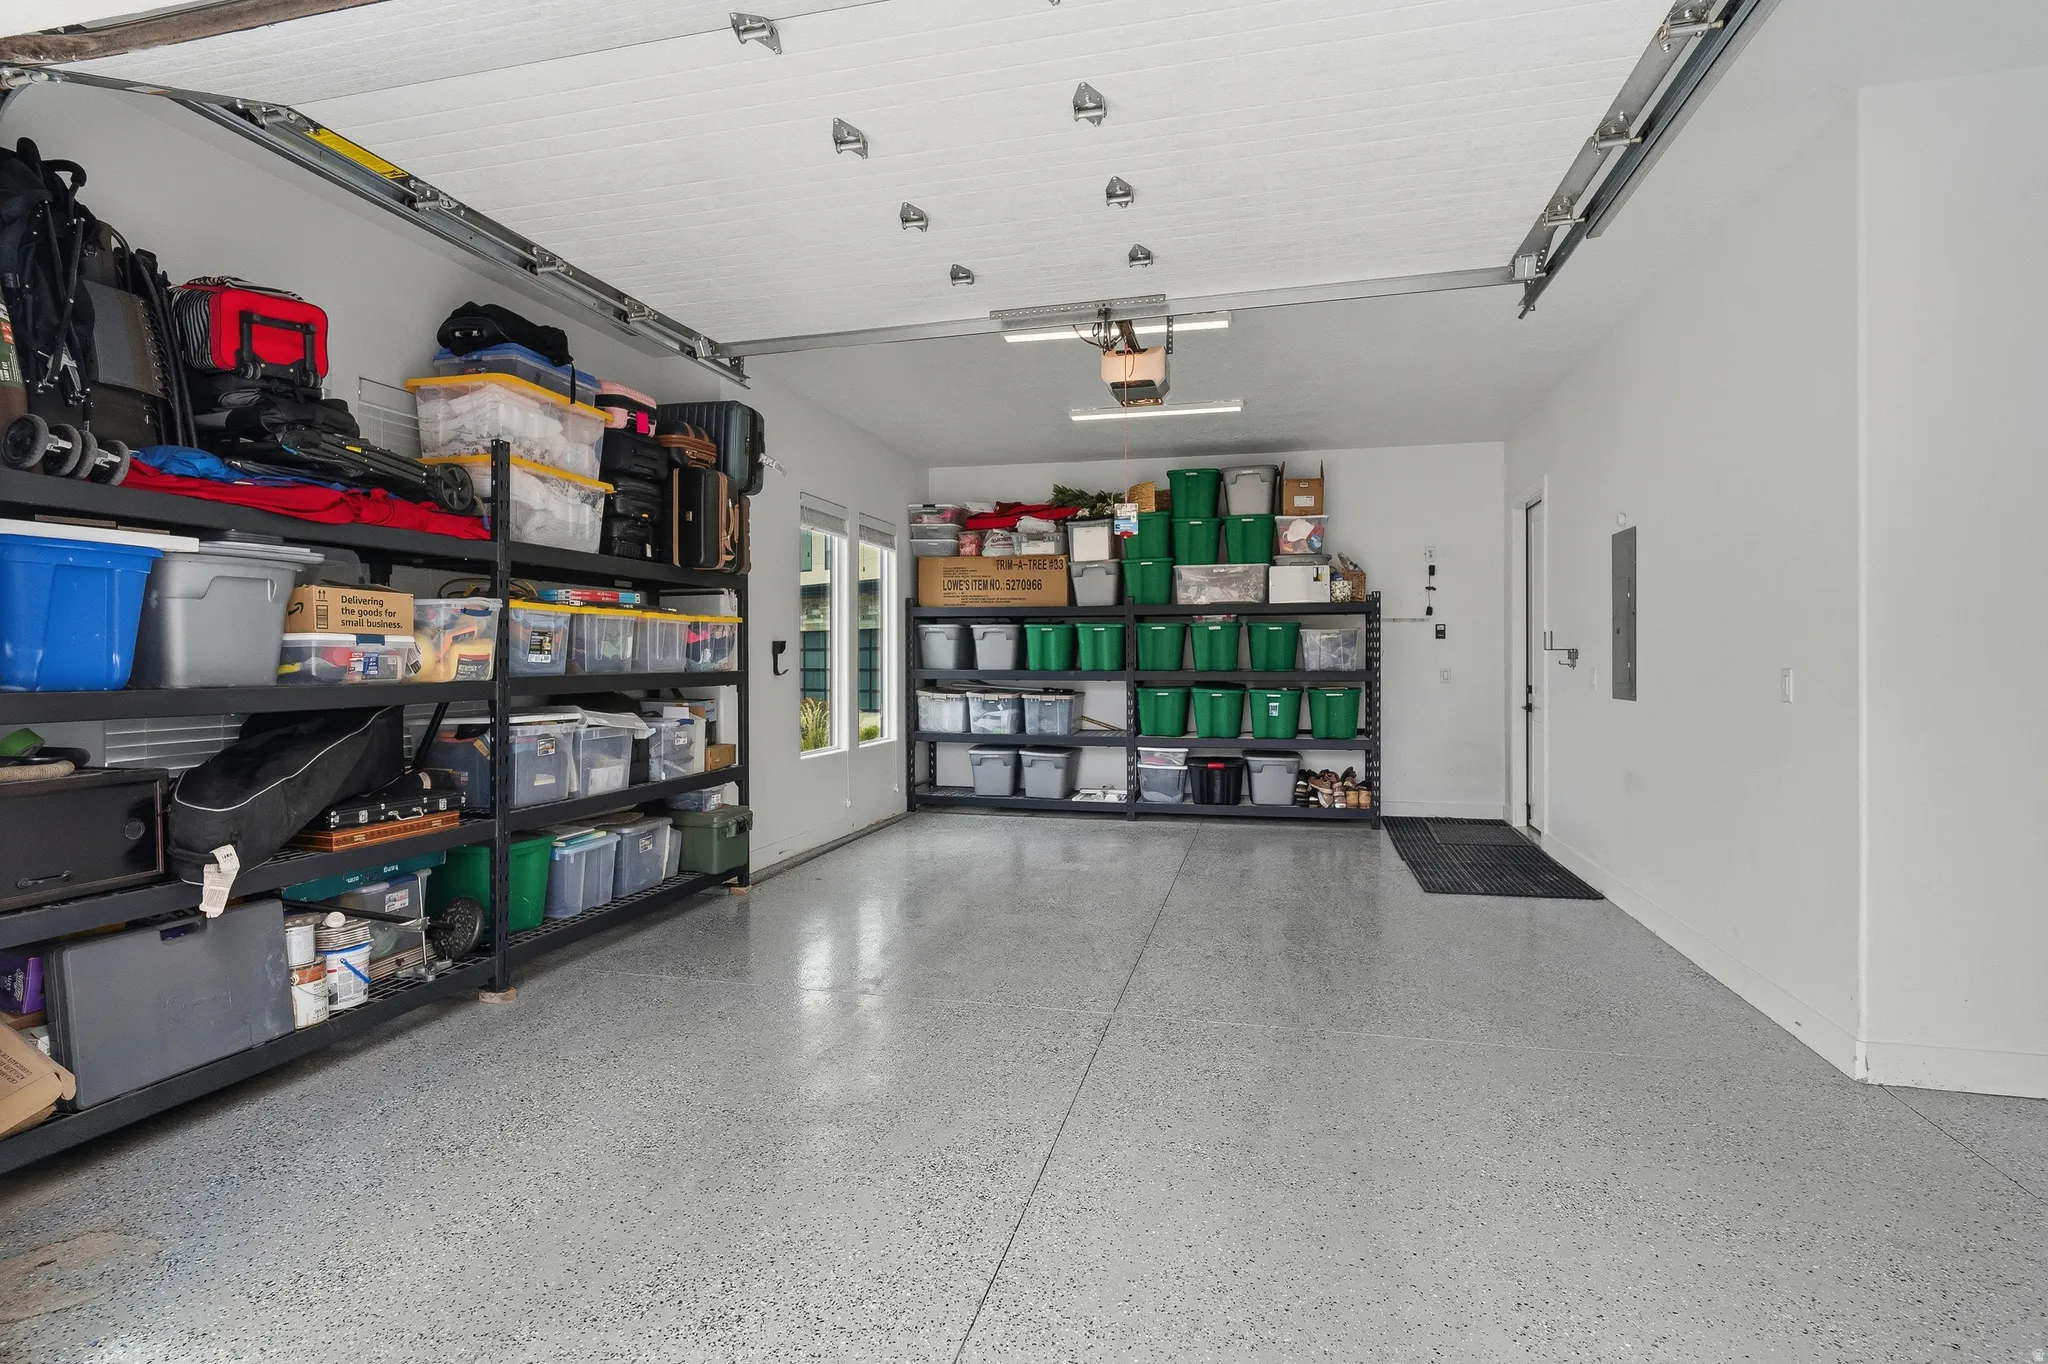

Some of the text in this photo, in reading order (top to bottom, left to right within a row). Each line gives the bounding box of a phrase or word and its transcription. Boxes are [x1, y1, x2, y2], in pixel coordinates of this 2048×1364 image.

[996, 559, 1047, 571] TRIM-A-TREE
[942, 579, 970, 591] LOWE'S
[971, 579, 989, 591] ITEM
[341, 595, 384, 608] Delivering
[341, 607, 397, 618] the goods for
[341, 619, 403, 629] small business.
